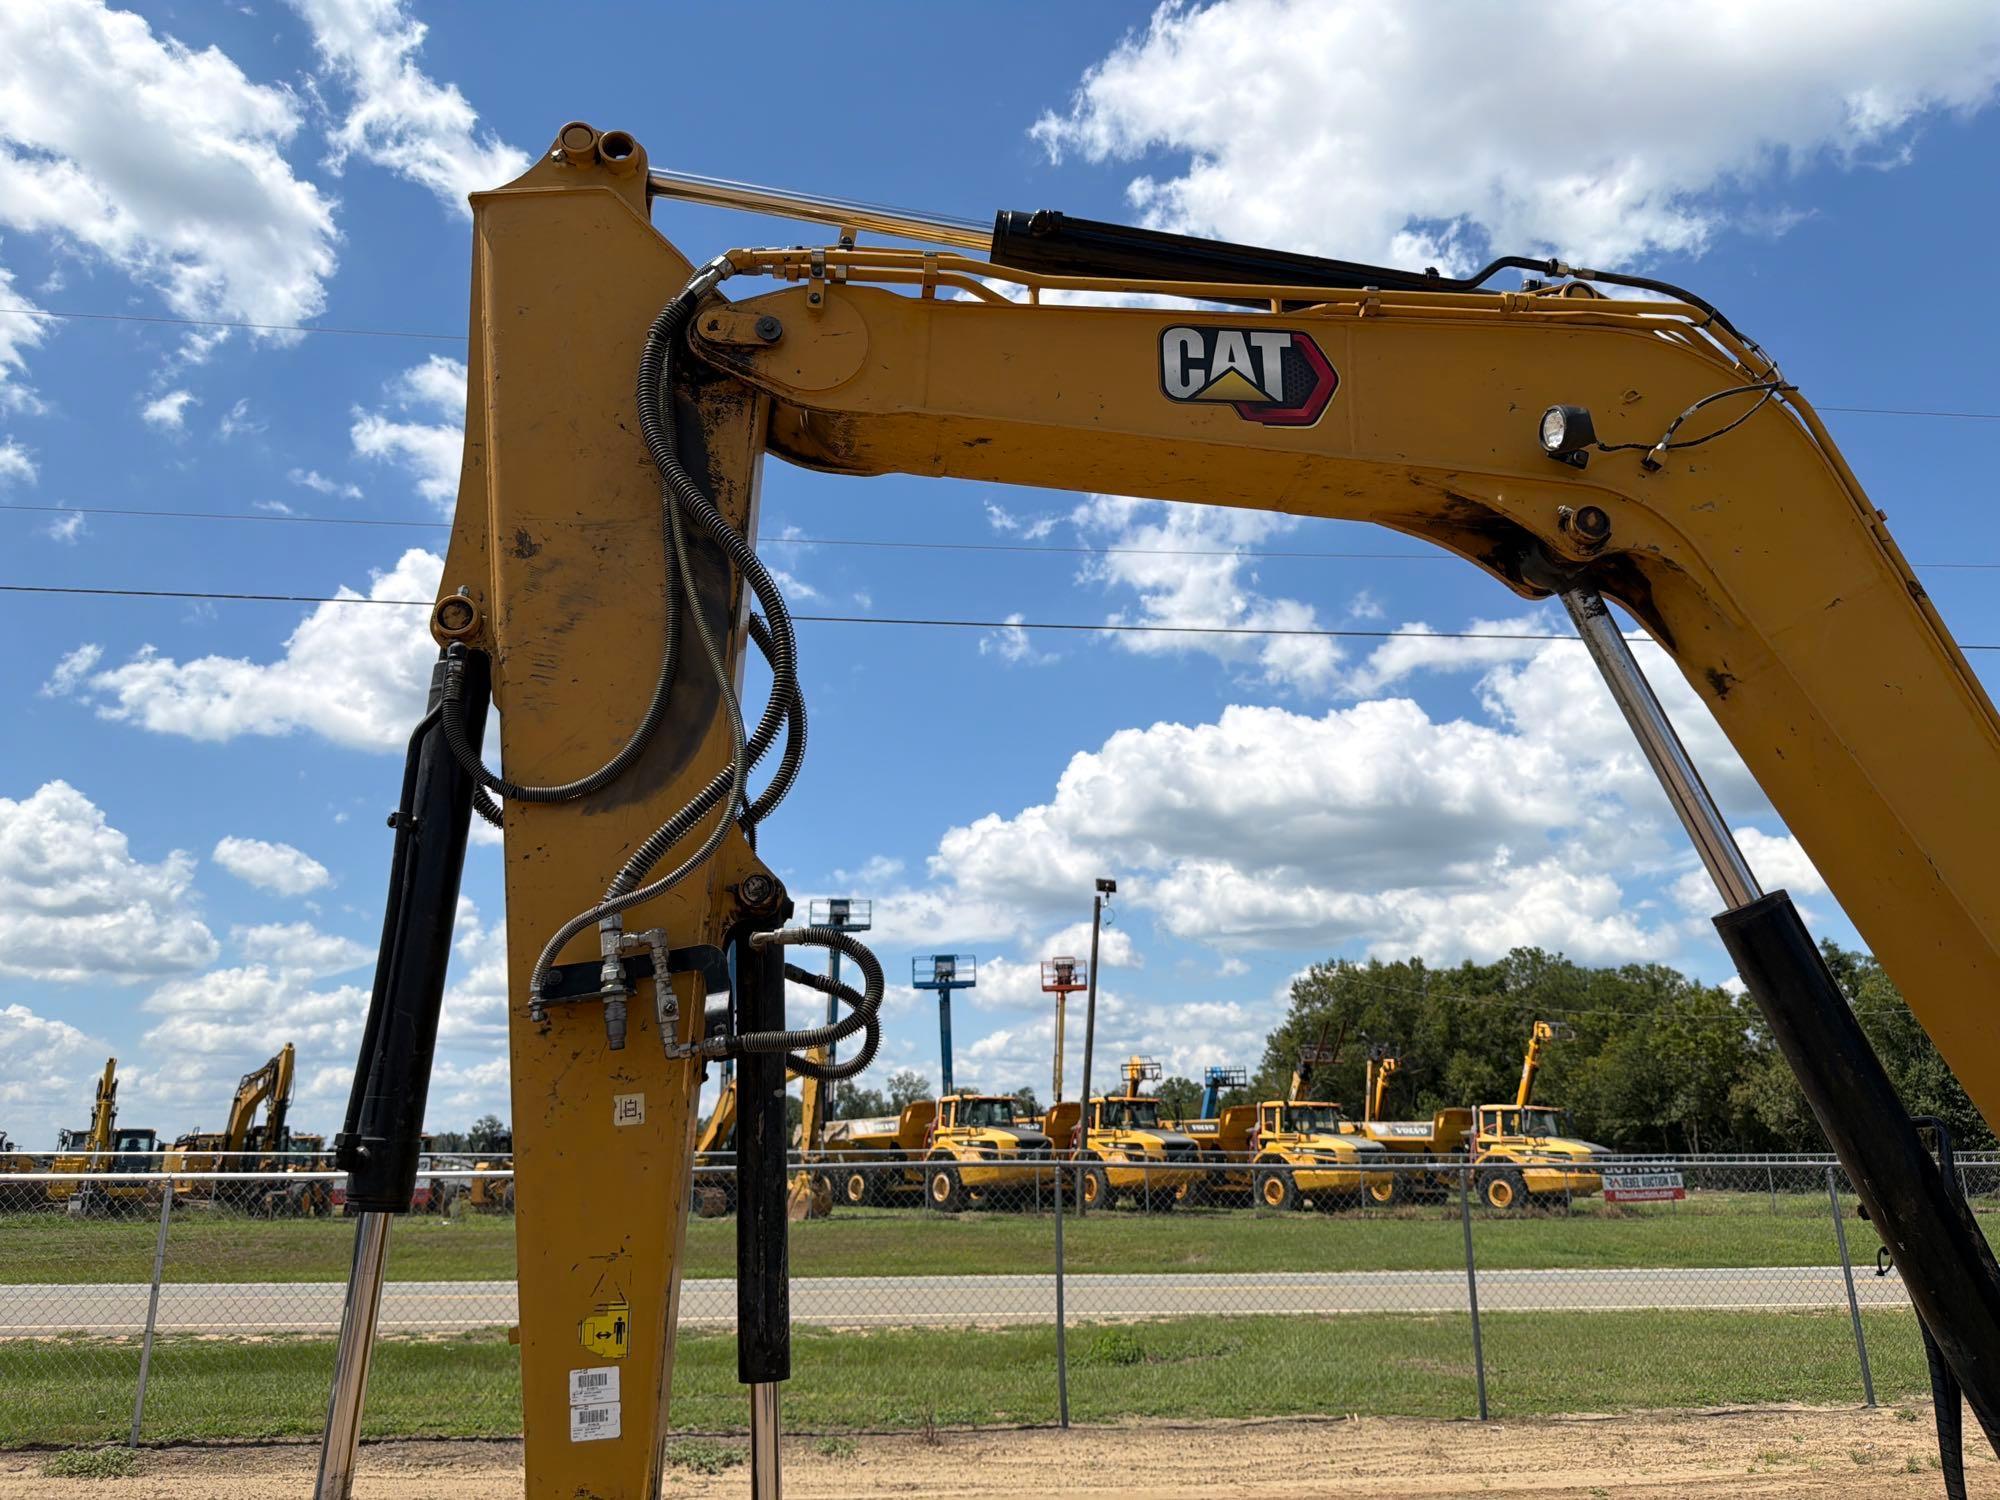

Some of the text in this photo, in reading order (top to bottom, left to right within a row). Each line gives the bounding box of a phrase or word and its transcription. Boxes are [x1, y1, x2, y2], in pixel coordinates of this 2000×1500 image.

[1163, 327, 1291, 402] CAT
[1395, 1127, 1428, 1135] VOLVO
[1642, 1176, 1669, 1187] AUCTION
